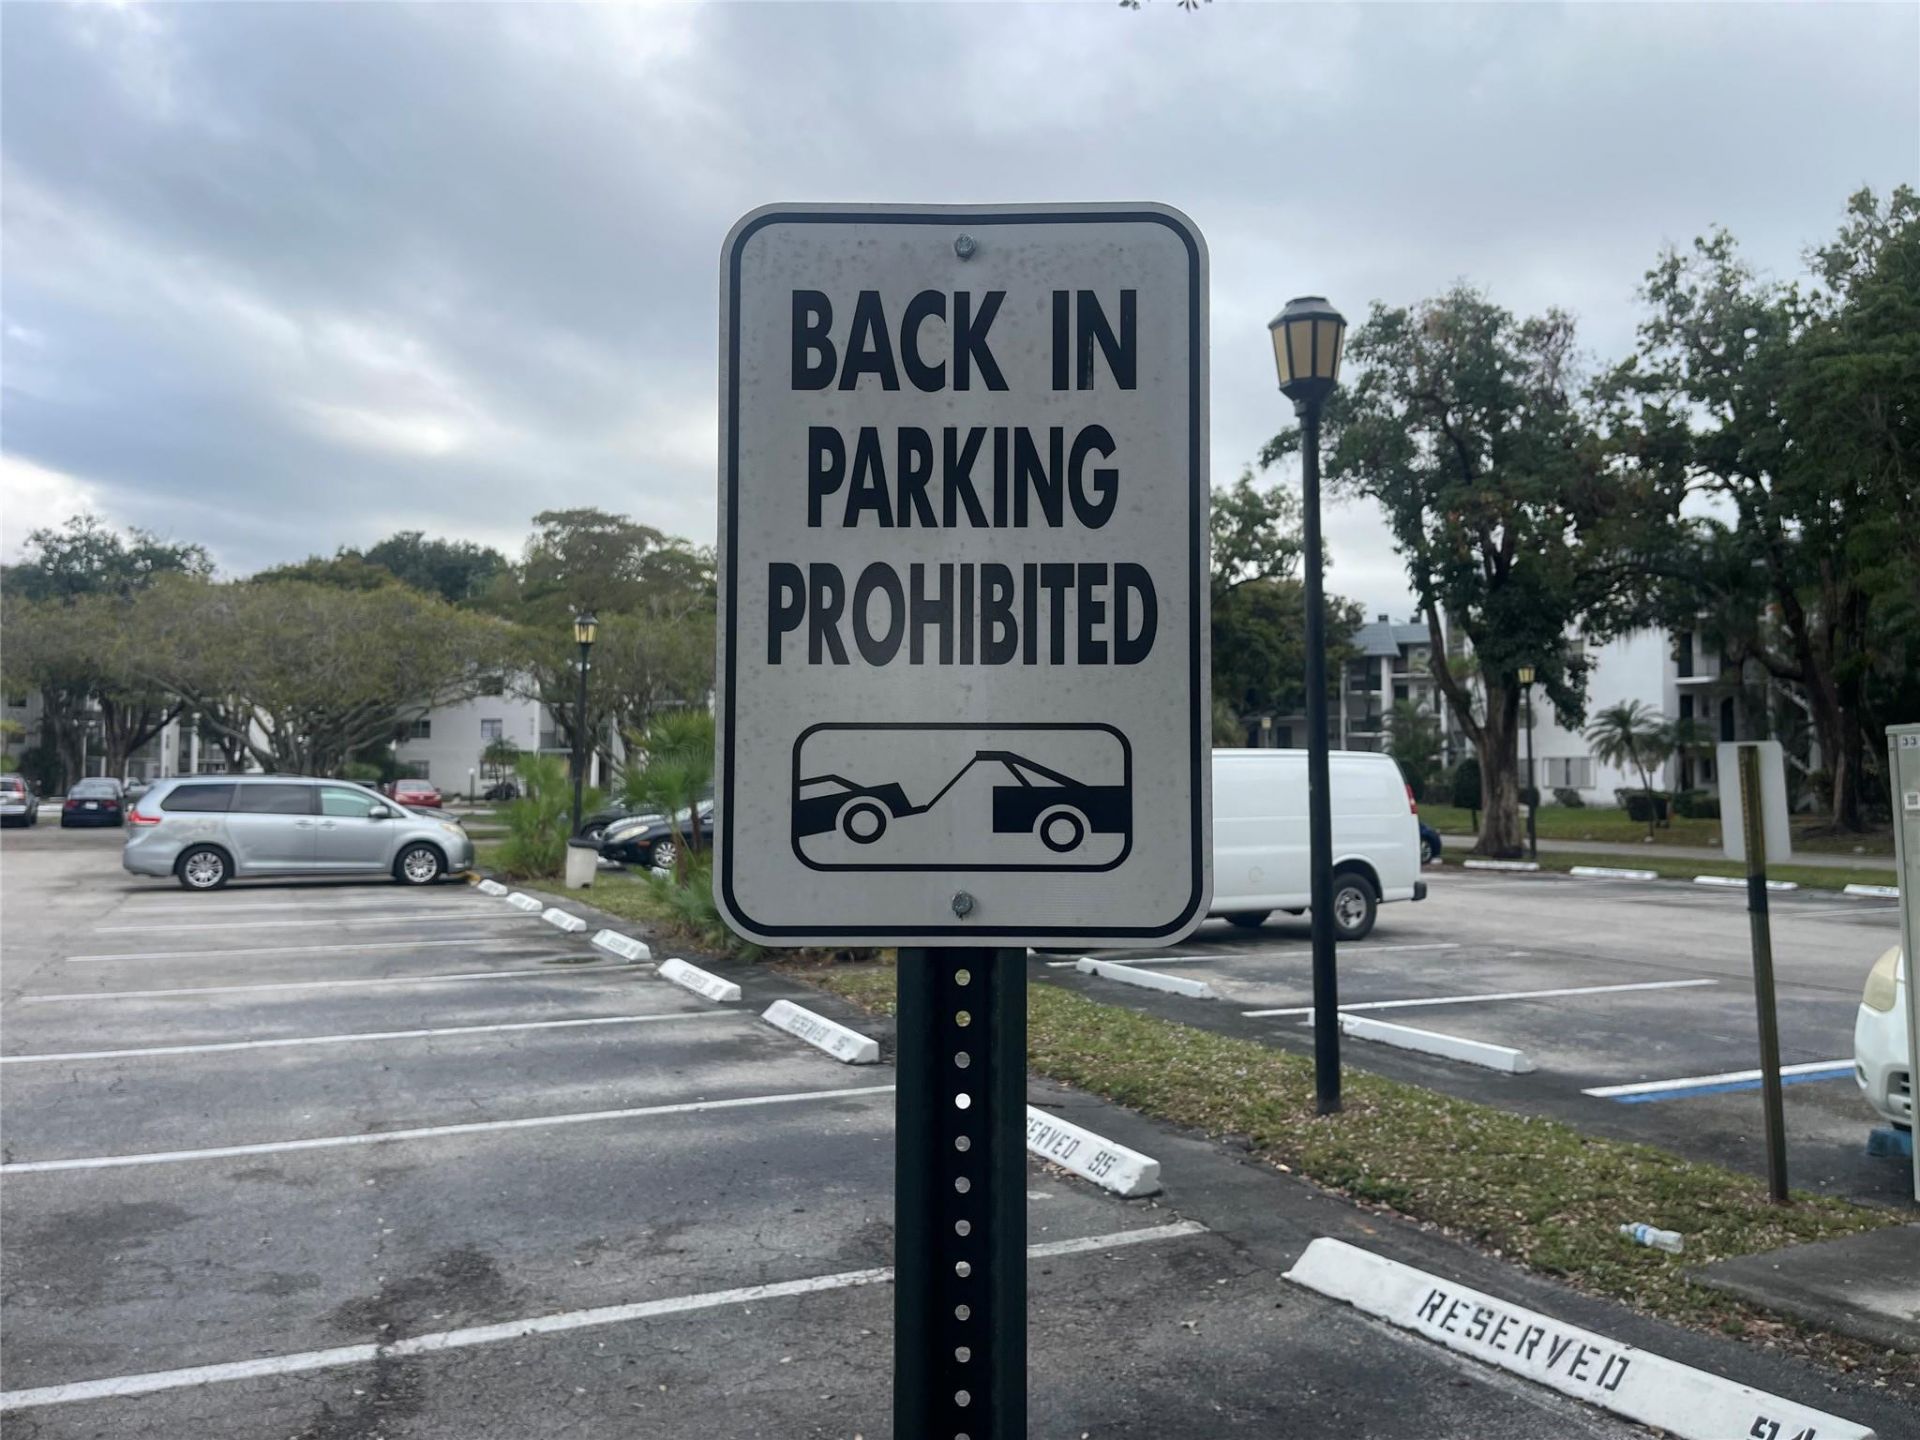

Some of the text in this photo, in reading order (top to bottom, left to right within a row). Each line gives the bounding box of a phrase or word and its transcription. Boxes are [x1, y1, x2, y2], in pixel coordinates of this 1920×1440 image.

[791, 289, 1137, 392] BACK IN
[807, 424, 1119, 529] PARKING
[767, 561, 1158, 667] PROHIBITED
[1027, 1116, 1117, 1178] ERVED 95
[1417, 1289, 1631, 1391] RESERVED
